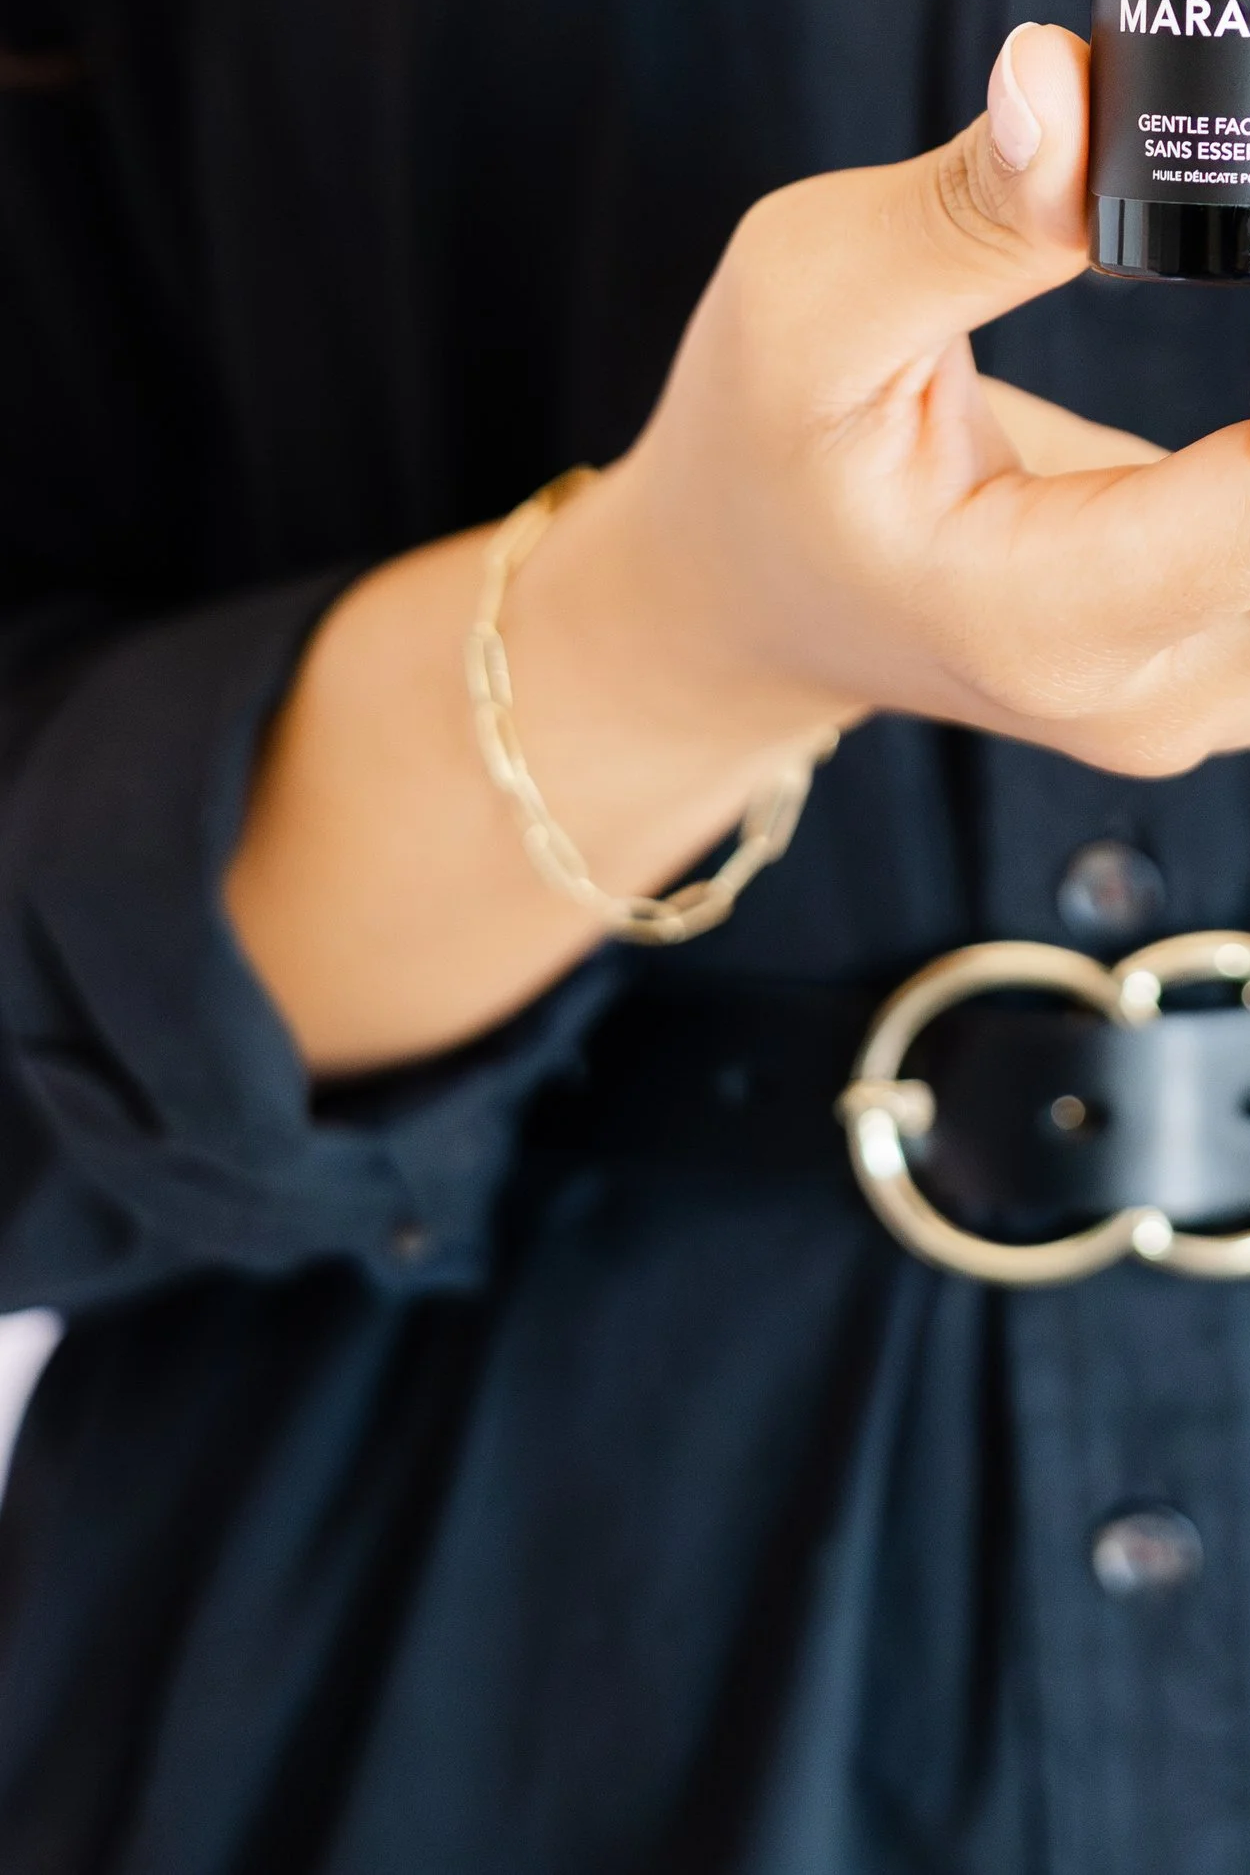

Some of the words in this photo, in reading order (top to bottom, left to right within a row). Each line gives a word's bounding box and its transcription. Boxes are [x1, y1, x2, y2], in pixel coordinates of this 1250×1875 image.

[1138, 114, 1210, 135] GENTLE
[1144, 139, 1192, 159] SANS
[1152, 169, 1182, 182] HUILE
[1184, 169, 1238, 184] DÉLICATE
